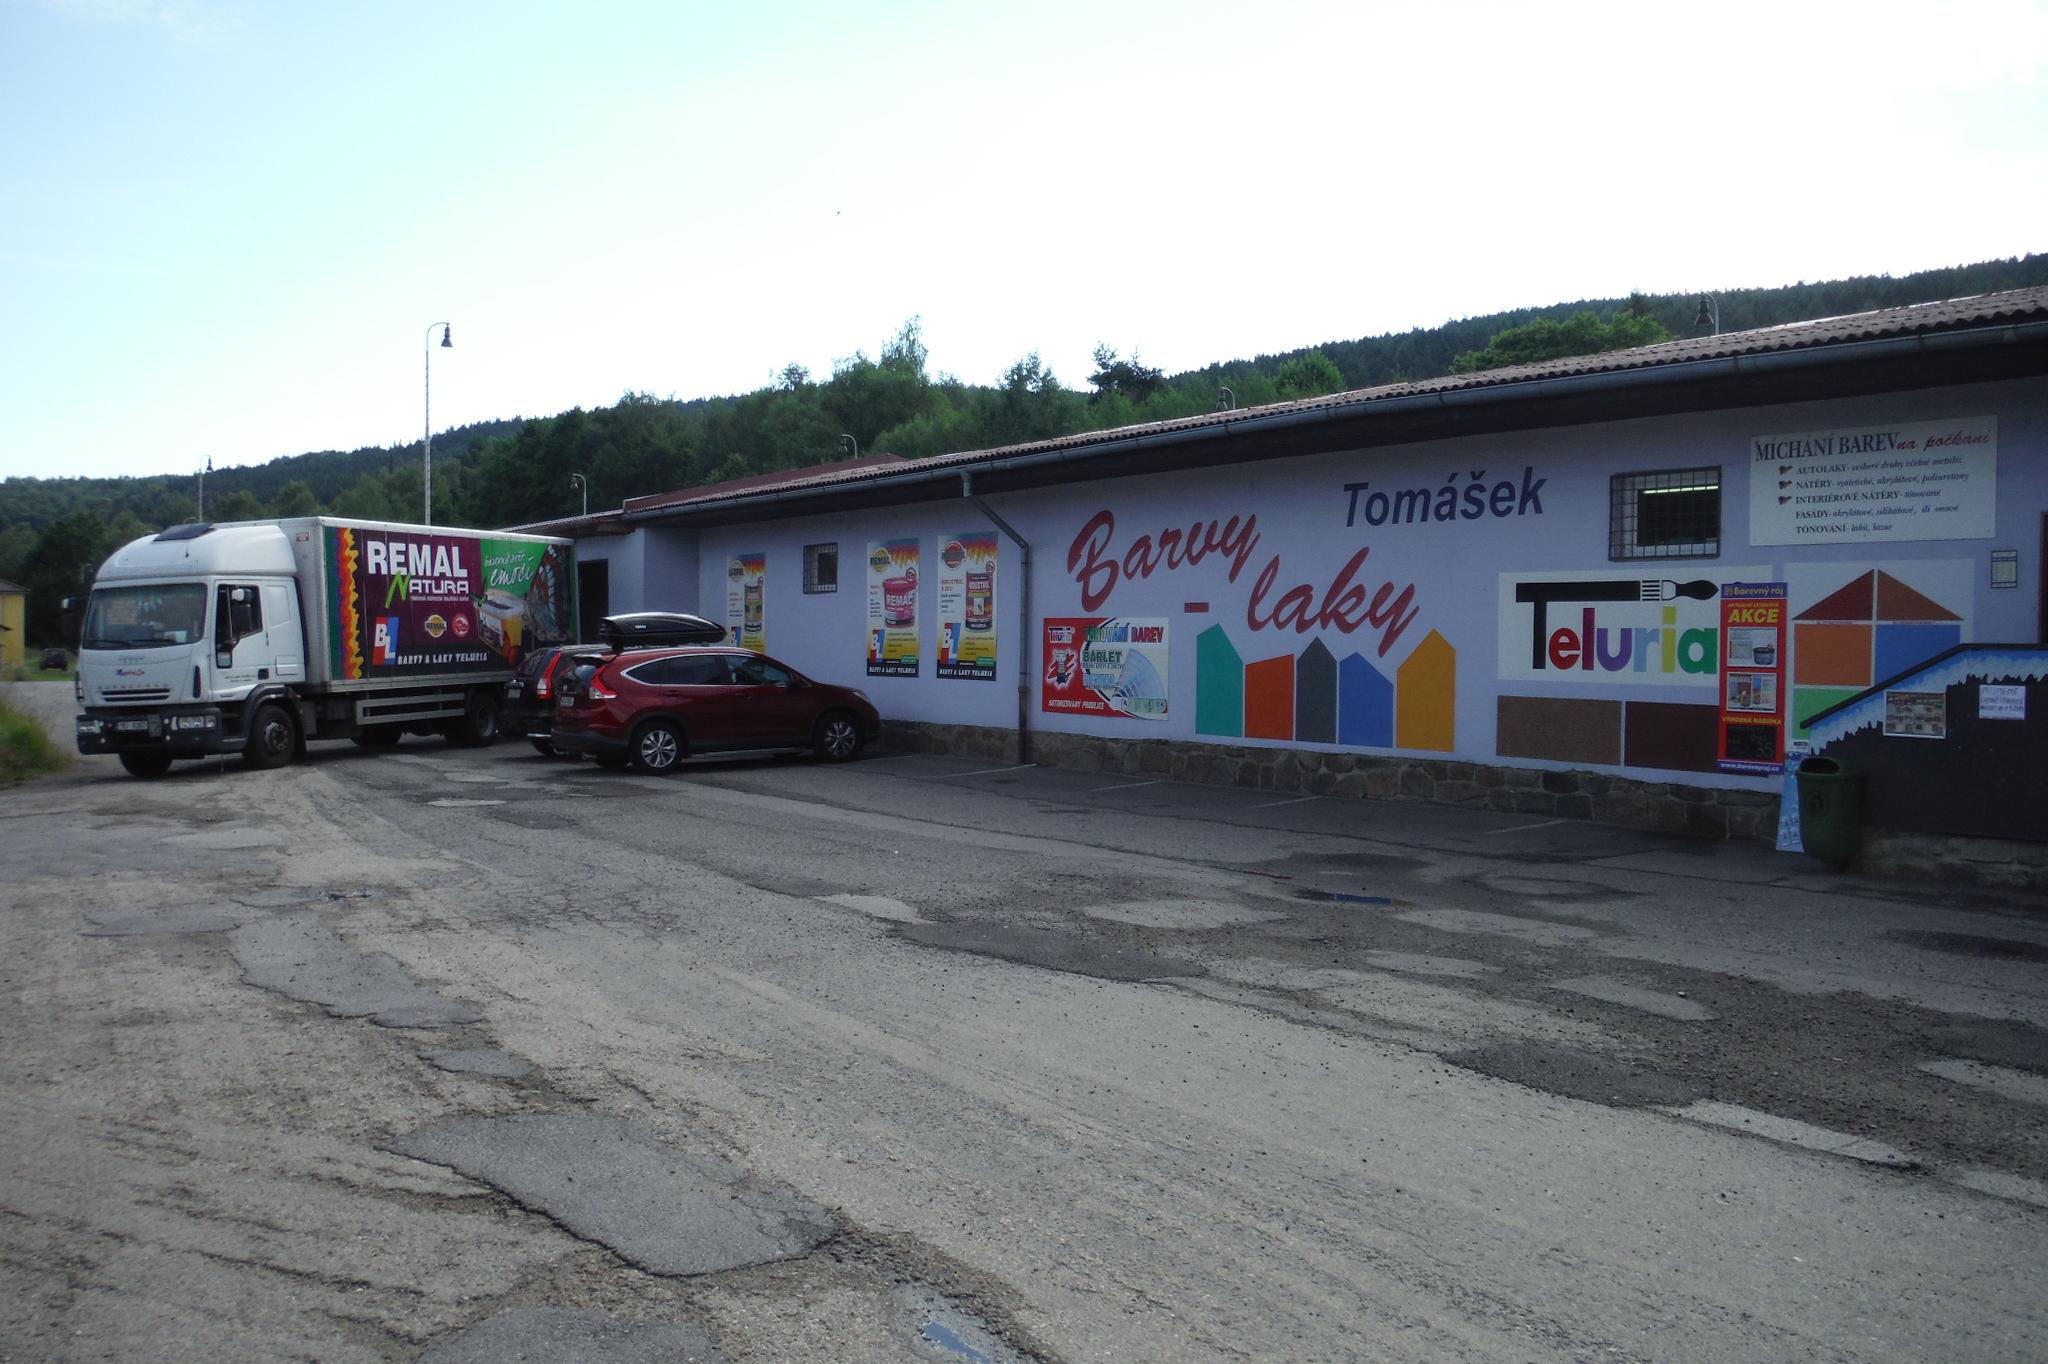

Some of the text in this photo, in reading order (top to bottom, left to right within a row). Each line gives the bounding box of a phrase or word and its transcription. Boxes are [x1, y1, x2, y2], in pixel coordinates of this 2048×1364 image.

[1755, 432, 1835, 462] MÍCHÁNÍ
[1839, 431, 1900, 455] BAREV
[1896, 440, 1918, 451] na
[1343, 466, 1549, 527] Tomášek
[366, 540, 469, 578] REMAL
[1067, 509, 1260, 613] Barvy
[385, 571, 470, 609] NATURA
[886, 594, 914, 607] REMAL
[1247, 546, 1420, 659] laky
[1733, 586, 1784, 597] Barevný ráj
[1515, 578, 1719, 675] Teluria
[1728, 608, 1780, 624] AKCE
[1131, 626, 1165, 644] BAREV
[397, 651, 488, 665] BARVY A LAKY TELURIA
